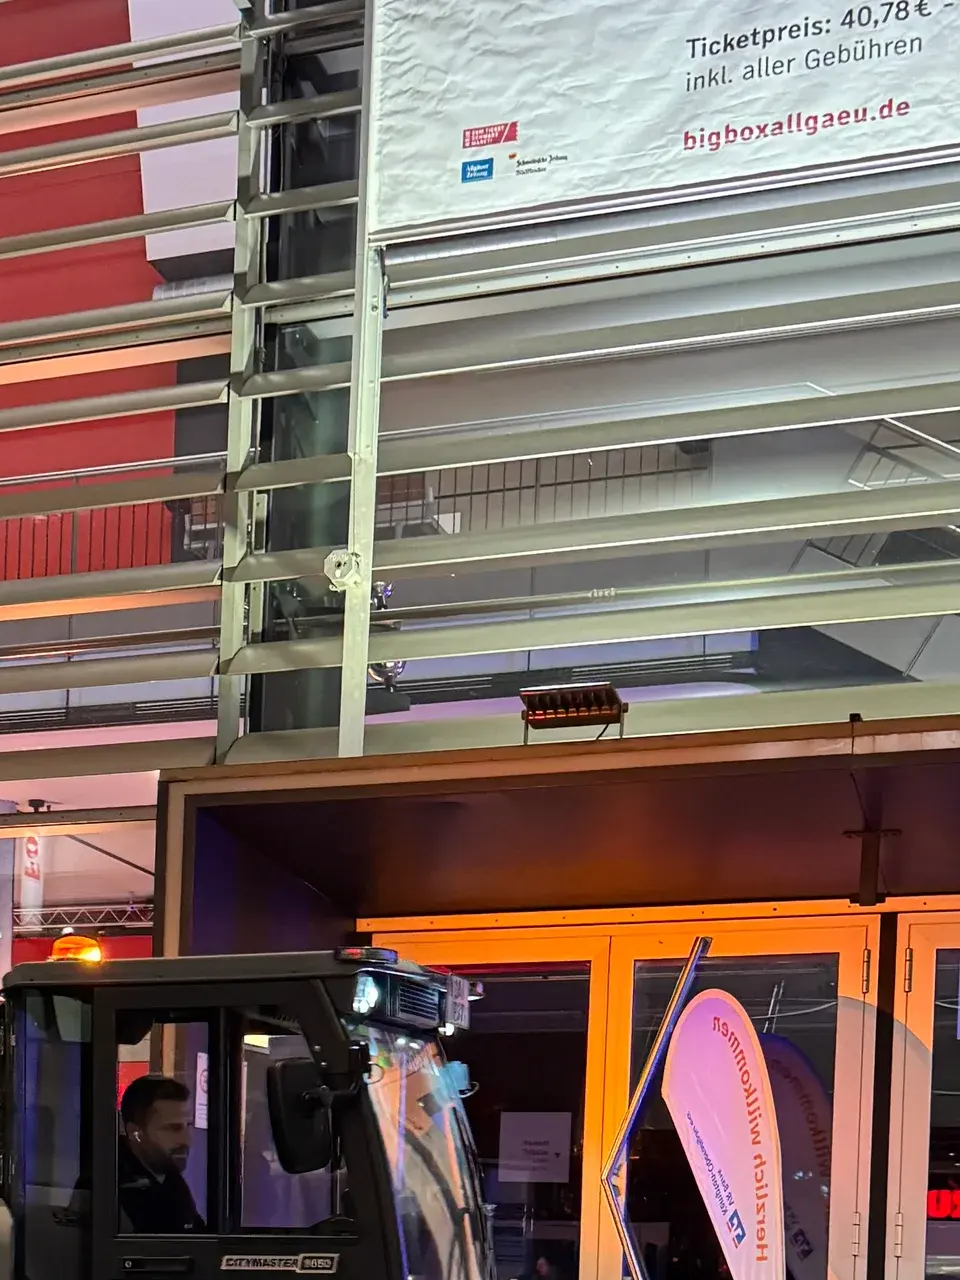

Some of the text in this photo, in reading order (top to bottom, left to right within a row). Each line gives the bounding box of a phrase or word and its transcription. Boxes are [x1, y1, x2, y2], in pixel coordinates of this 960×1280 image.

[685, 16, 832, 59] Ticketpreis:
[840, 0, 910, 29] 40,78
[685, 36, 923, 92] inkl. aller Gebühren
[683, 98, 911, 152] bigboxallgaeu.de
[224, 1257, 299, 1268] CITYMASTER
